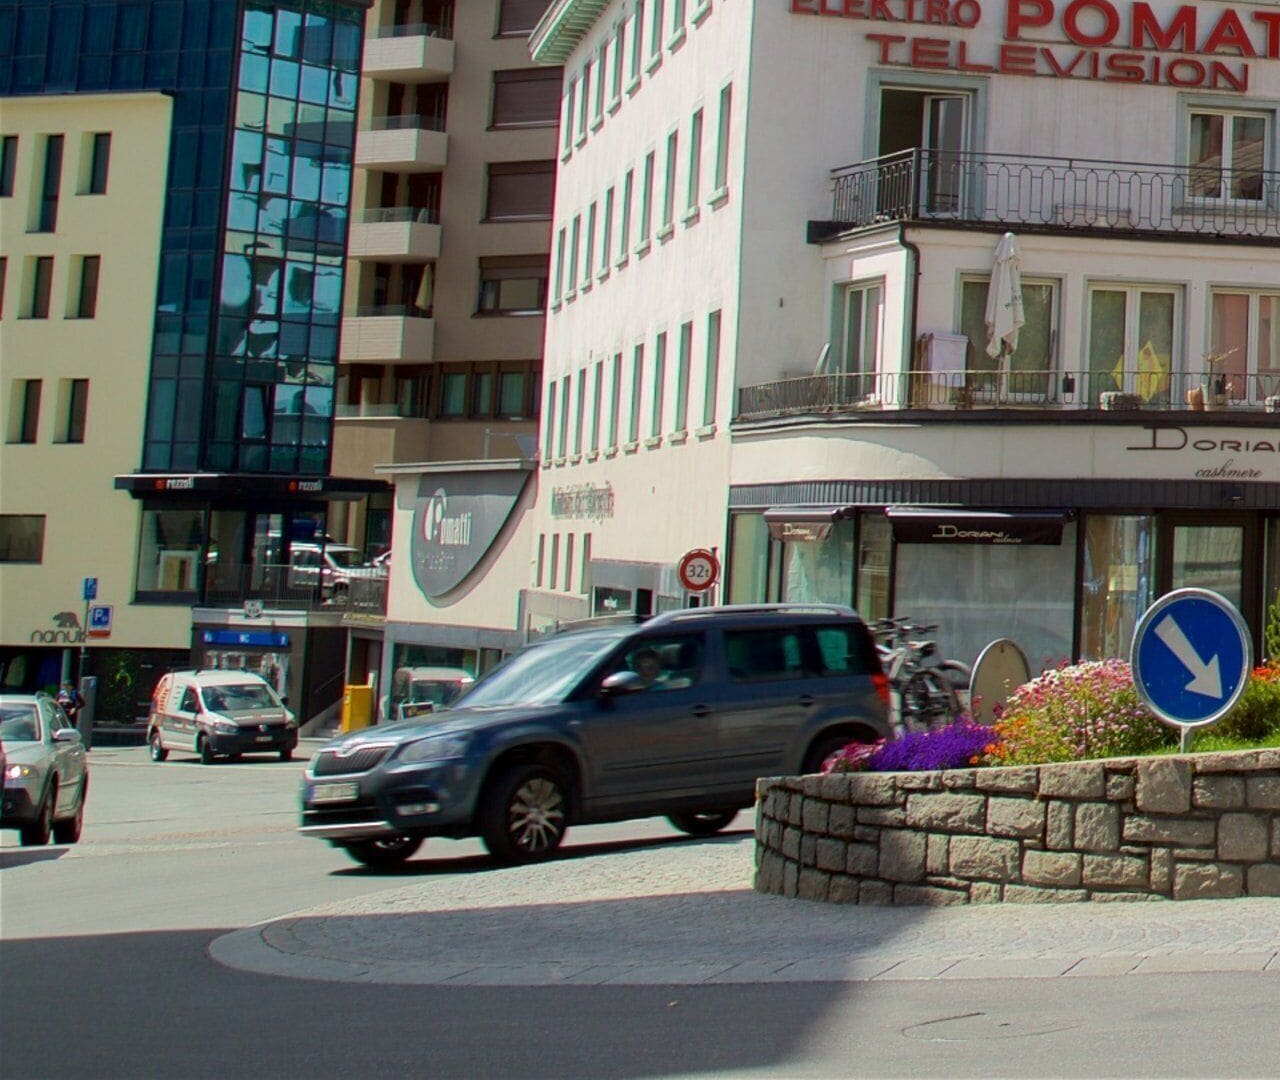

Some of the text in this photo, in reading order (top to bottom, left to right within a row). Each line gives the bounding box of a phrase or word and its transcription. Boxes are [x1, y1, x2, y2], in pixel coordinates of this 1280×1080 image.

[866, 33, 1250, 92] TELEVISION
[1194, 458, 1263, 479] cashmere
[687, 564, 710, 578] 32t
